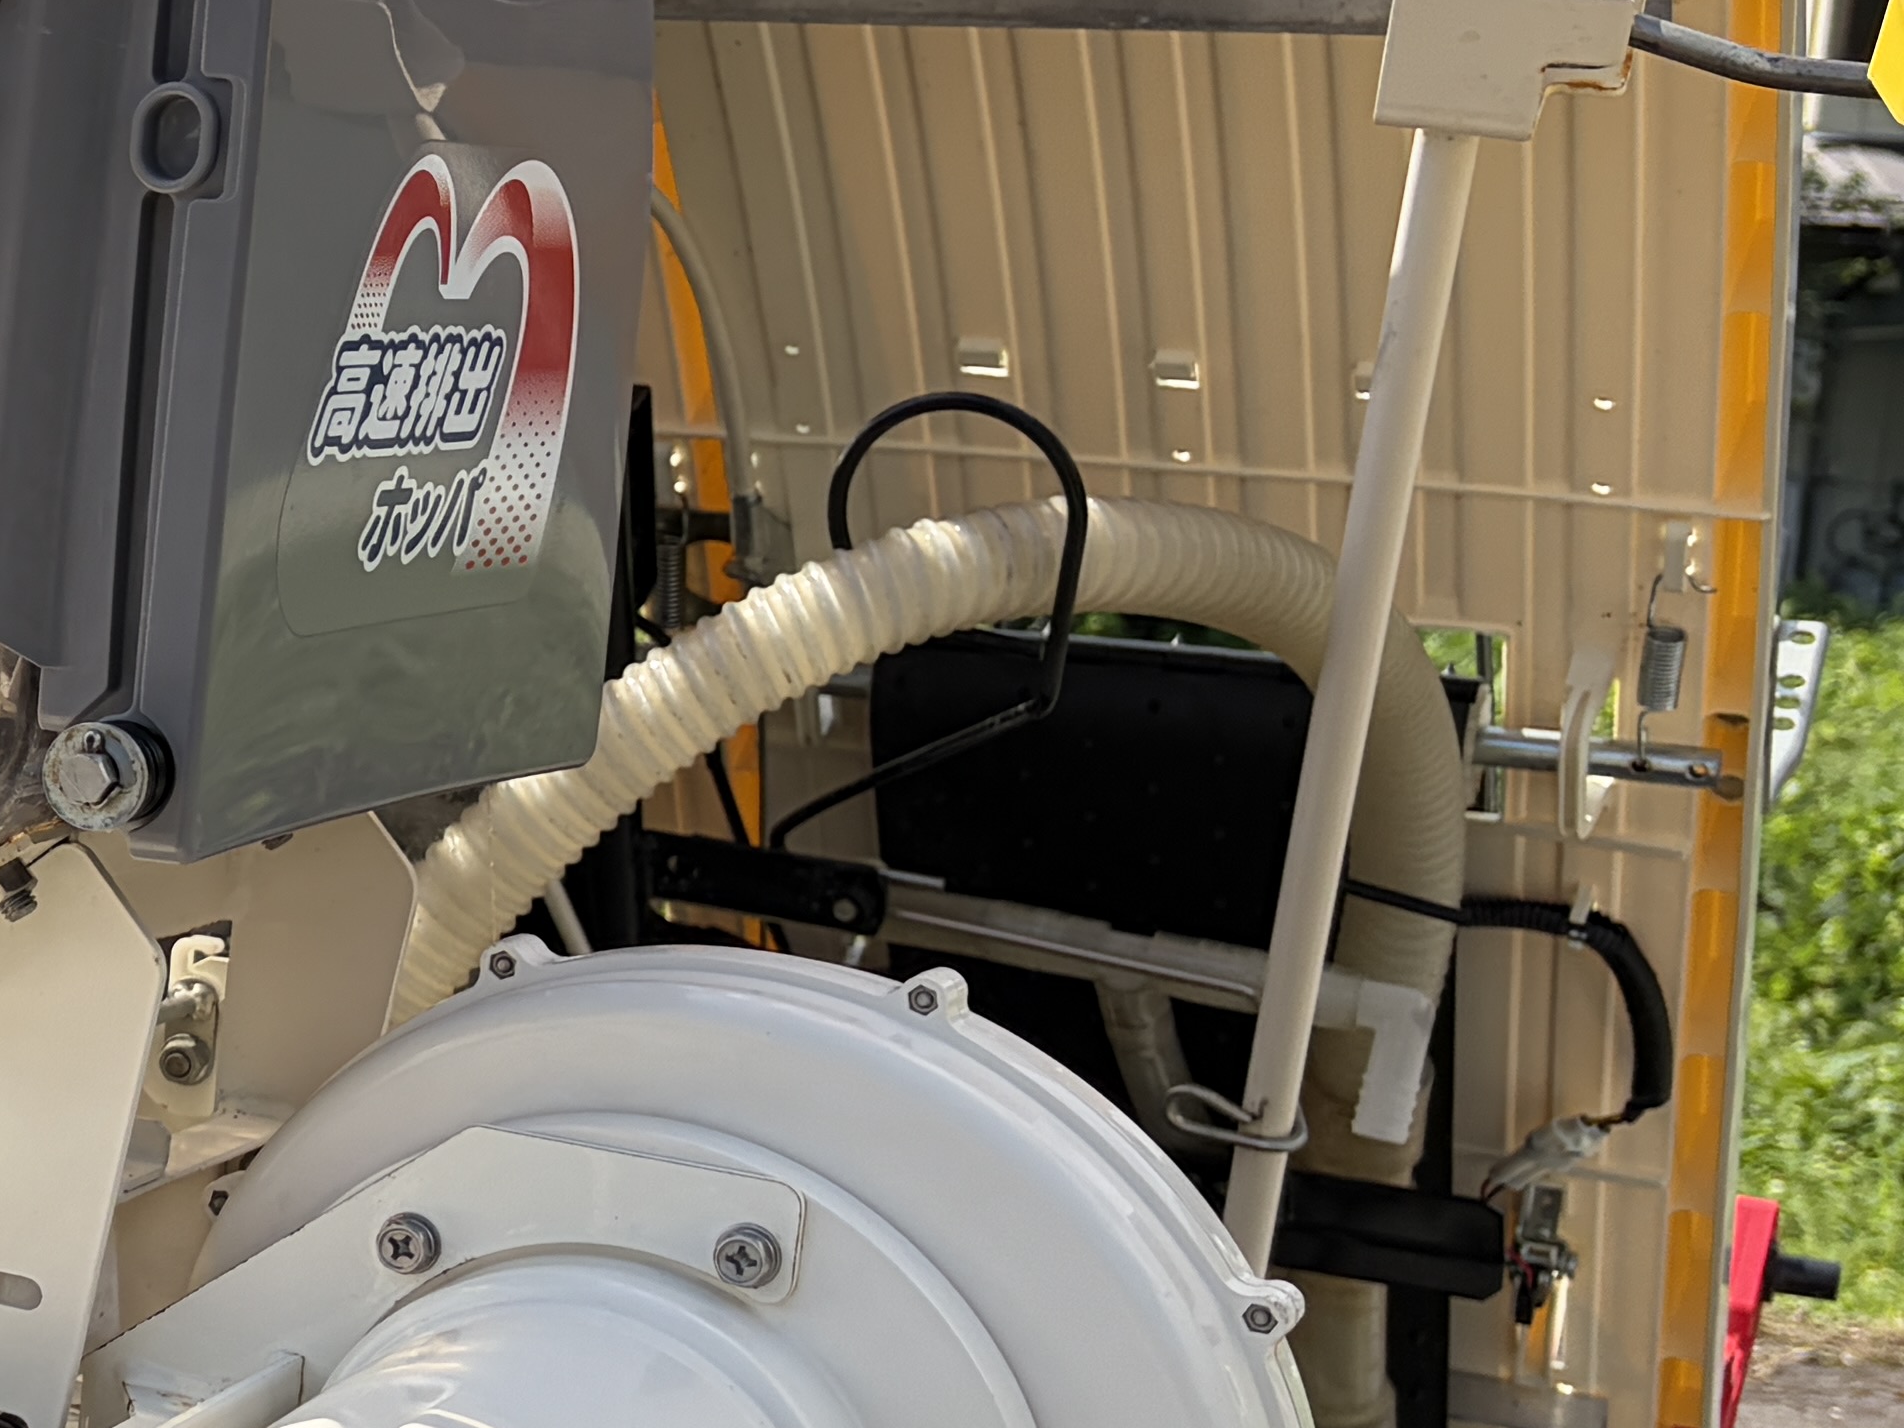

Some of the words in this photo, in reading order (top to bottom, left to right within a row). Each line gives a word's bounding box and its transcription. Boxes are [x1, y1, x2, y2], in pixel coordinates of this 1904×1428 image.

[309, 327, 504, 462] 高速排出
[360, 467, 488, 569] ホッパ
